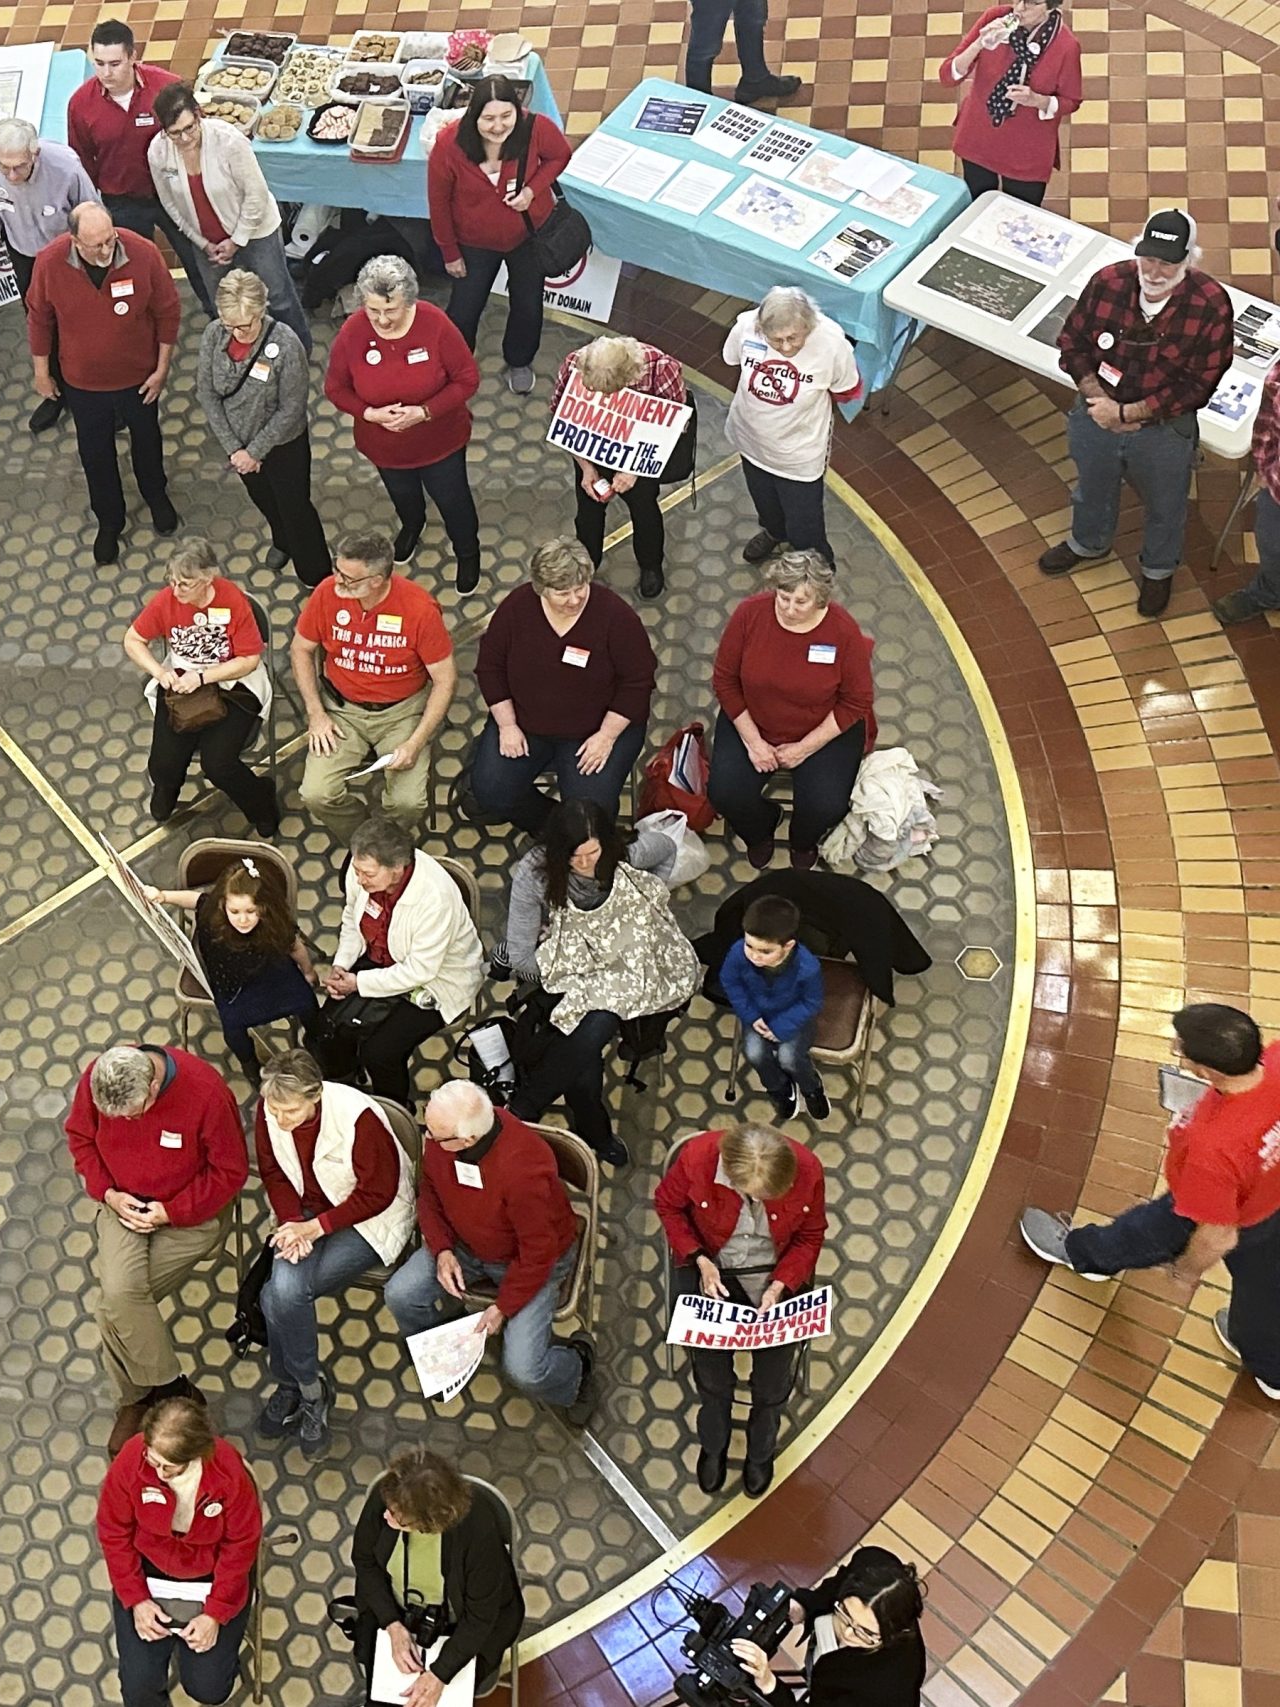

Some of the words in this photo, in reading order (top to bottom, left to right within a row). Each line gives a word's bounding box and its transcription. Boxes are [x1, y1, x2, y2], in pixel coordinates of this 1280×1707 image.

[558, 294, 592, 314] DOMAIN
[744, 356, 814, 383] Hazardous
[559, 396, 636, 443] DOMAIN
[550, 419, 634, 469] PROTECT
[636, 441, 659, 459] THE
[629, 455, 663, 475] LAND
[331, 624, 352, 642] THIS
[354, 632, 363, 645] IS
[366, 633, 407, 648] AMERICA
[341, 646, 356, 660] WE
[682, 1296, 724, 1313] LAND
[726, 1289, 828, 1324] PROTECT
[694, 1308, 722, 1324] THE
[735, 1305, 827, 1336] DOMAIN
[680, 1329, 786, 1347] EMINENT
[793, 1318, 826, 1339] NO
